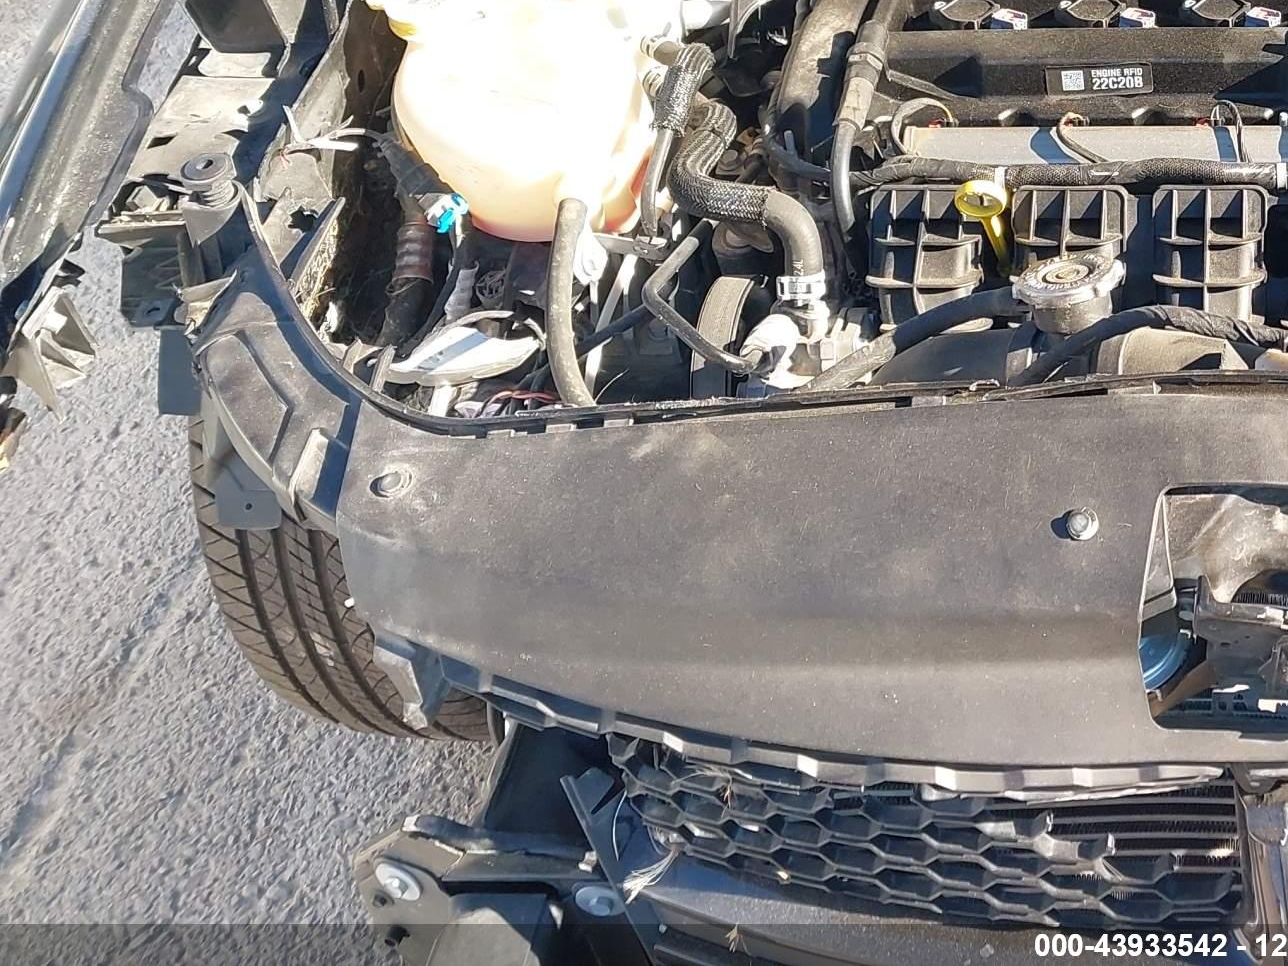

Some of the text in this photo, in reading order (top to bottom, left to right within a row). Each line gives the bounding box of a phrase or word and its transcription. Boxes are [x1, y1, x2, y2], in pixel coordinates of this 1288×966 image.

[1091, 67, 1143, 78] ENGINE RFID
[1091, 76, 1144, 91] 22C20B
